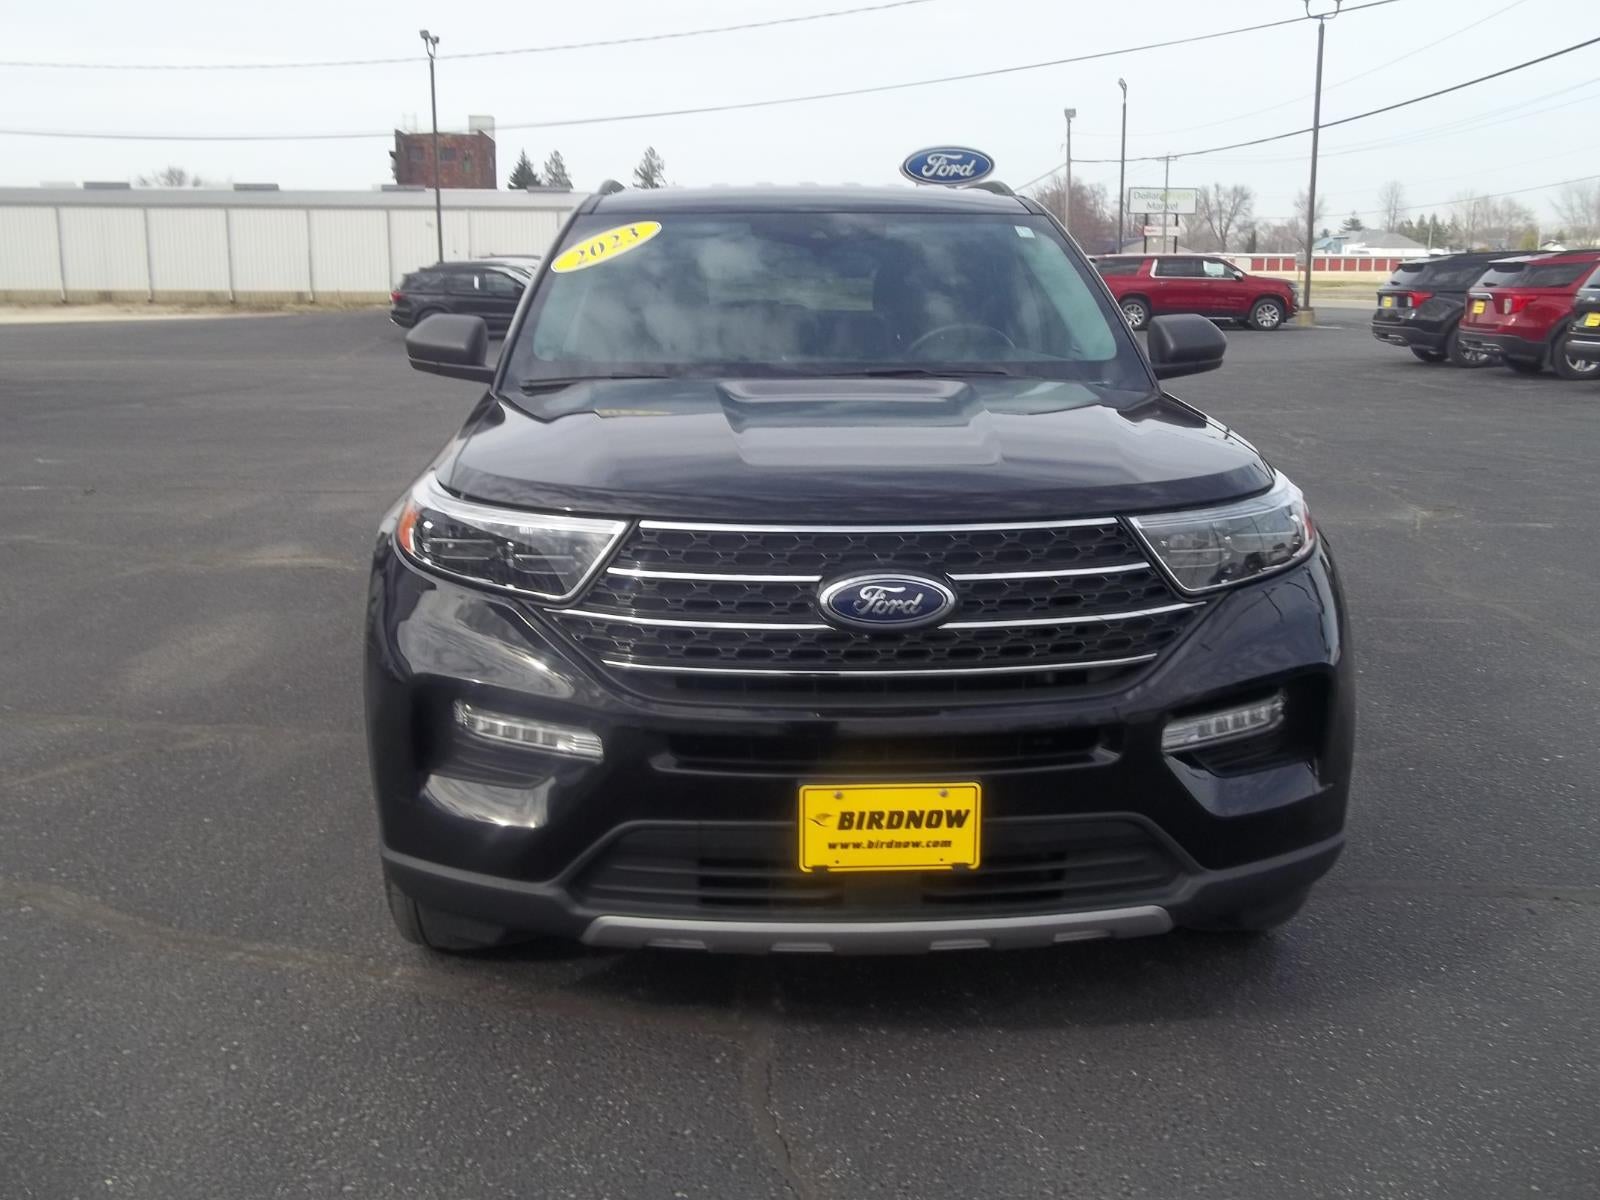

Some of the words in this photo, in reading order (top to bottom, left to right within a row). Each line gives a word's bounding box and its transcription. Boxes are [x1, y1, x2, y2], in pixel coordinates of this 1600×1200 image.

[921, 153, 976, 177] Ford
[576, 226, 642, 265] 2023
[853, 585, 924, 615] Ford
[837, 808, 971, 831] BIRDNOW
[827, 839, 953, 850] www.birdnow.com
